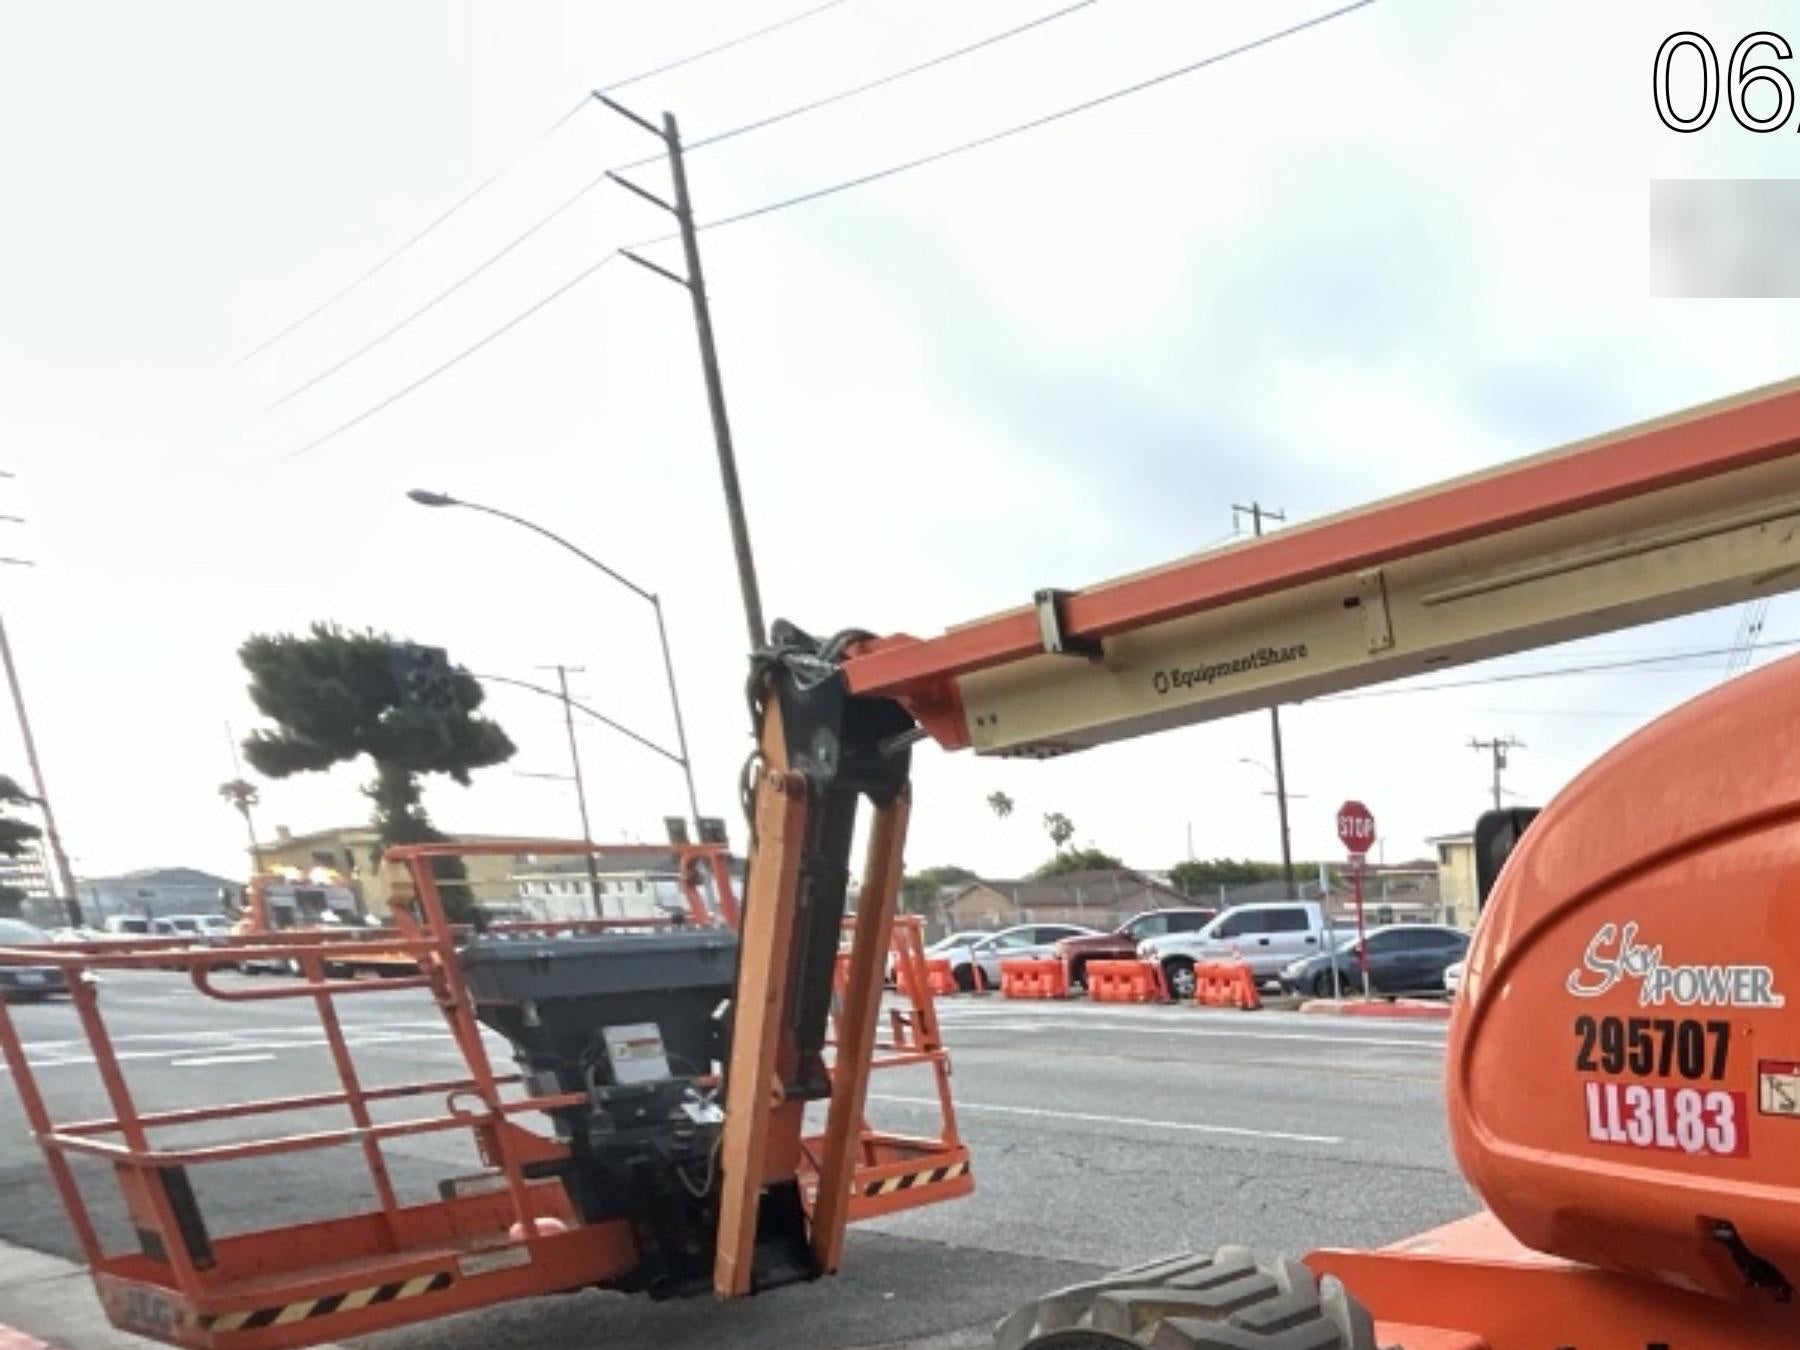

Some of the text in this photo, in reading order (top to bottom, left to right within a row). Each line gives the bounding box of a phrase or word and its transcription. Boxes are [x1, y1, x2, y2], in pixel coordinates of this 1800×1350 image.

[1170, 643, 1309, 689] EquipmentShare
[1340, 815, 1374, 838] STOP
[1573, 1013, 1730, 1081] 295707
[1585, 1081, 1740, 1156] LL3L83
